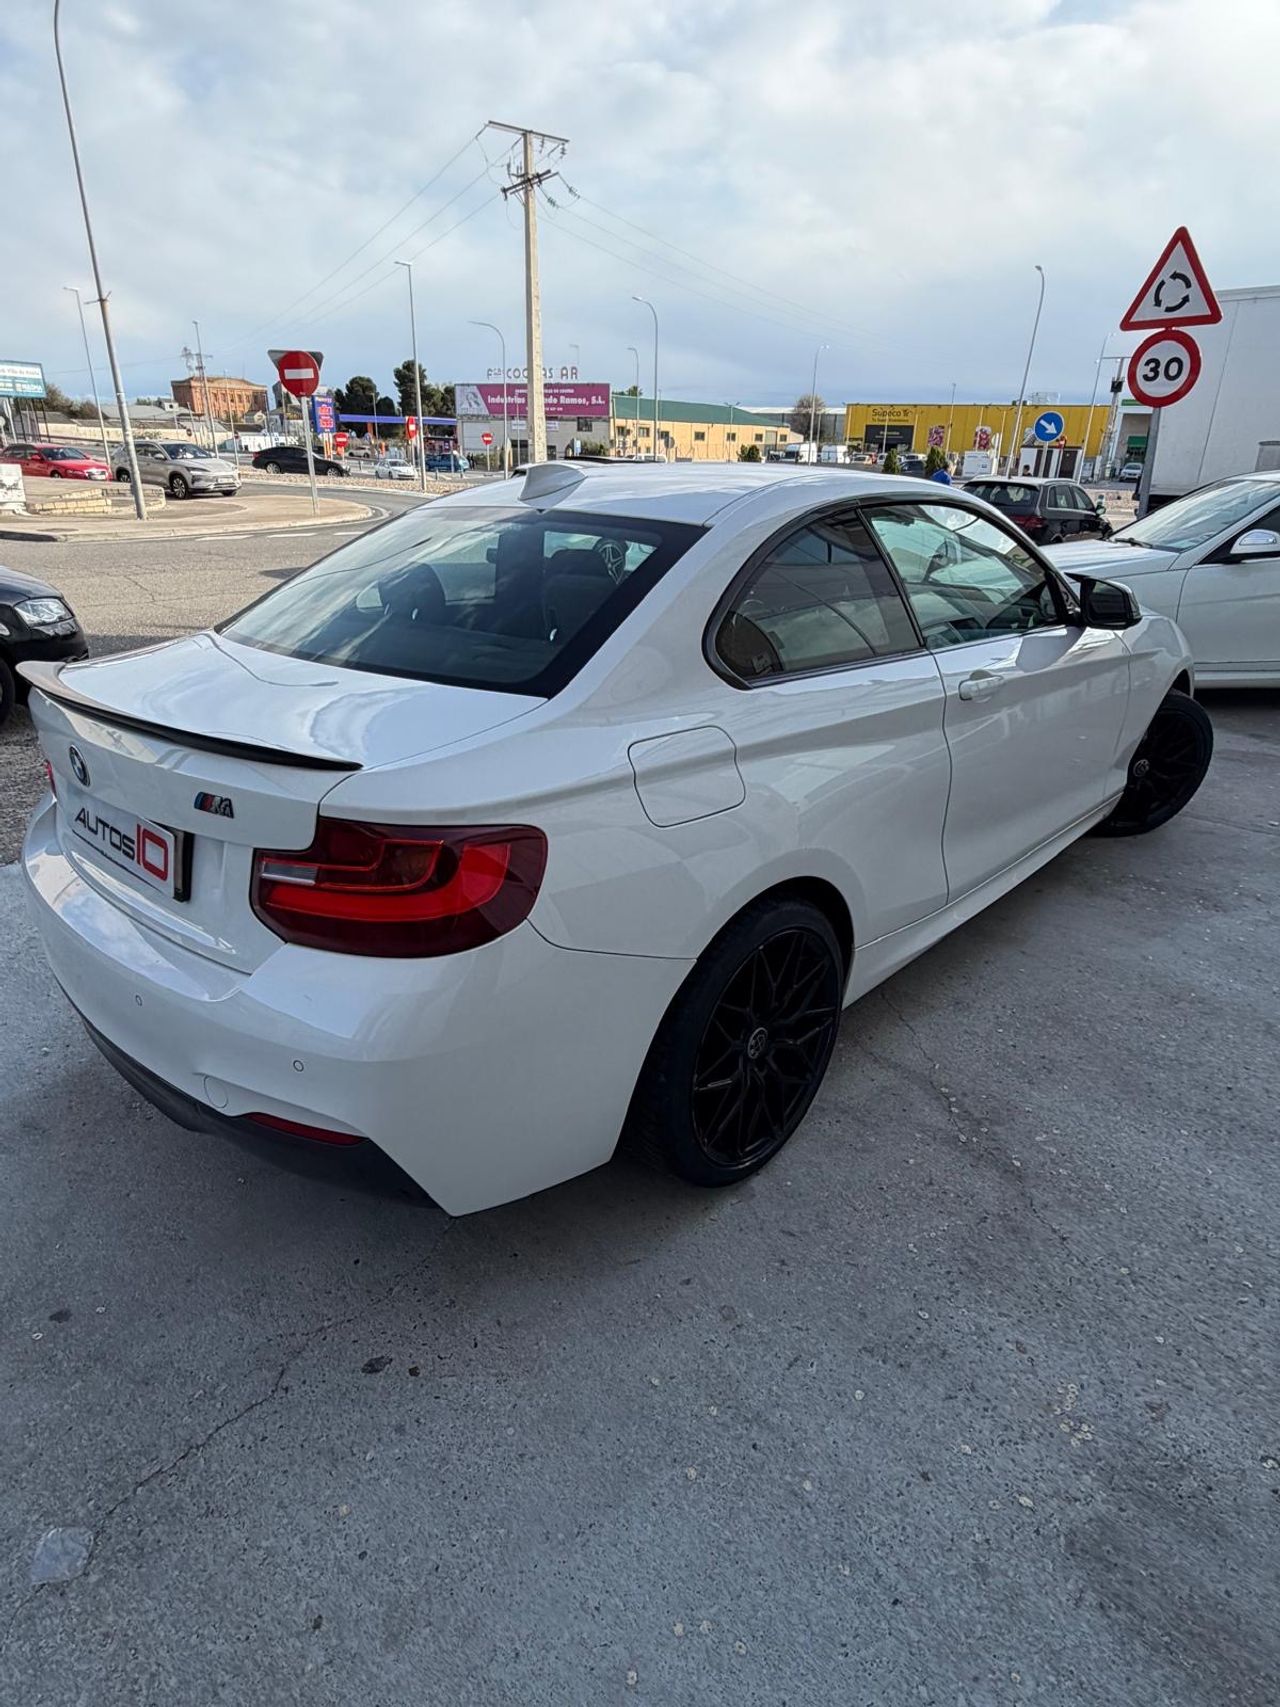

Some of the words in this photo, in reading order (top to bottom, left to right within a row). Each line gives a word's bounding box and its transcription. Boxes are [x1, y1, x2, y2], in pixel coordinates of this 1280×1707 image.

[560, 366, 578, 380] AR
[1142, 357, 1184, 382] 30
[560, 395, 590, 406] Ramos,
[591, 395, 606, 405] S.L.
[871, 408, 902, 417] Supeco
